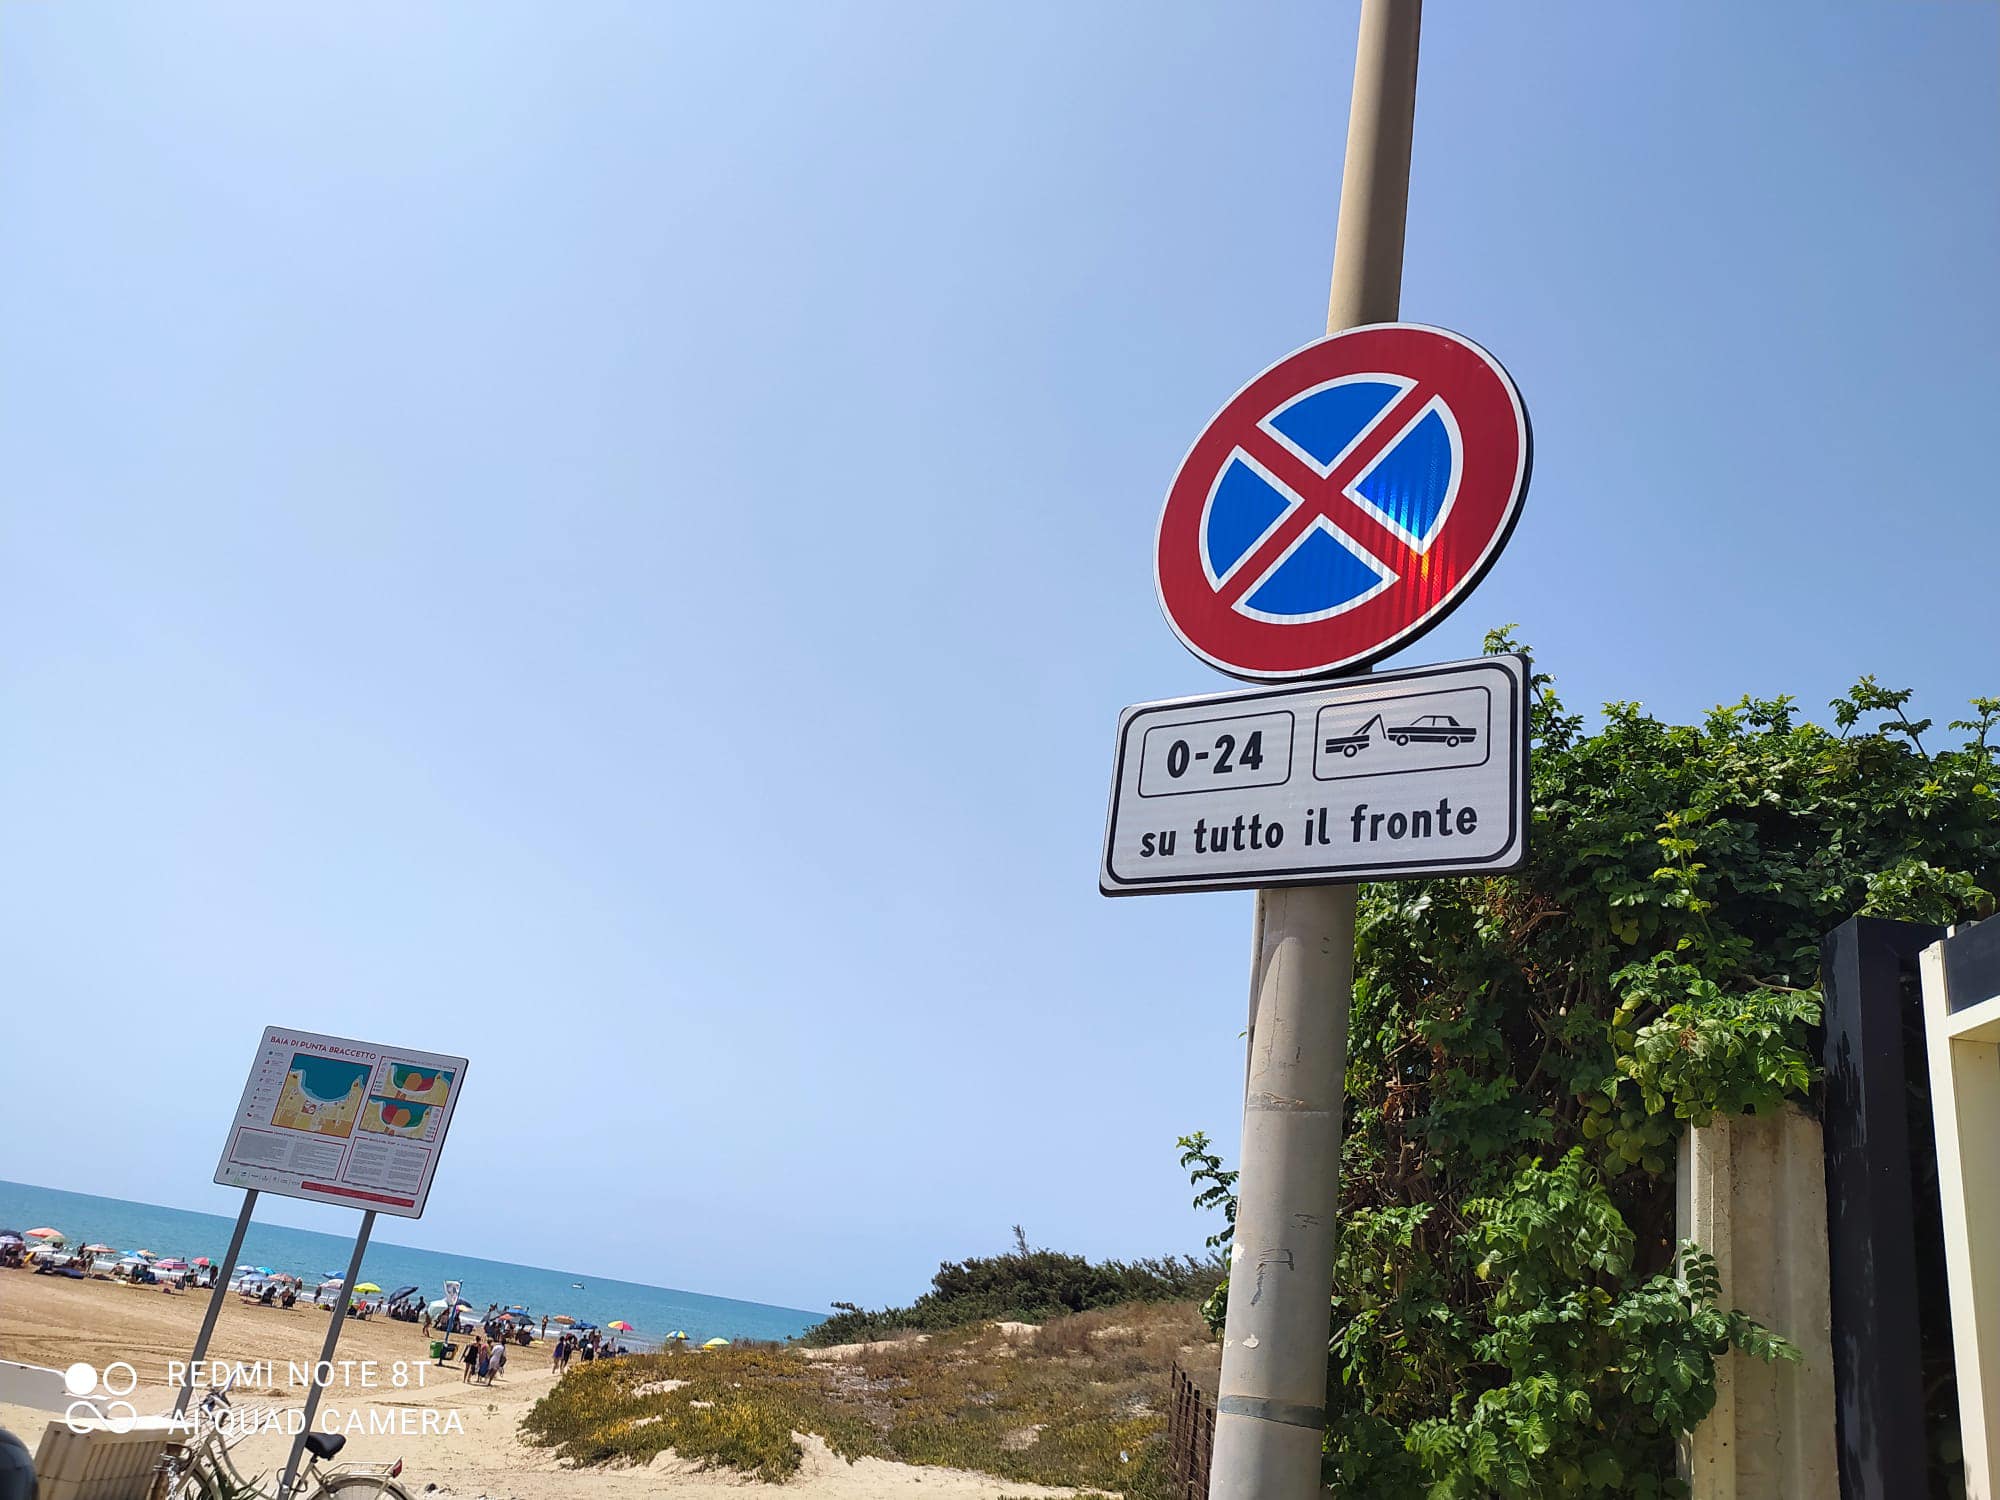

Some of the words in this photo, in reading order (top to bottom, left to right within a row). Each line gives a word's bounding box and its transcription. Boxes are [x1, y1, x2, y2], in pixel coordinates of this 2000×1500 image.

[1167, 731, 1263, 779] 0-24
[1140, 830, 1176, 858] su
[1194, 813, 1284, 854] tutto
[1304, 807, 1331, 846] il
[1351, 798, 1478, 843] fronte
[270, 1036, 288, 1045] BAIA
[290, 1039, 299, 1047] DI
[299, 1041, 327, 1051] PUNTA
[329, 1046, 376, 1060] BRACCETTO
